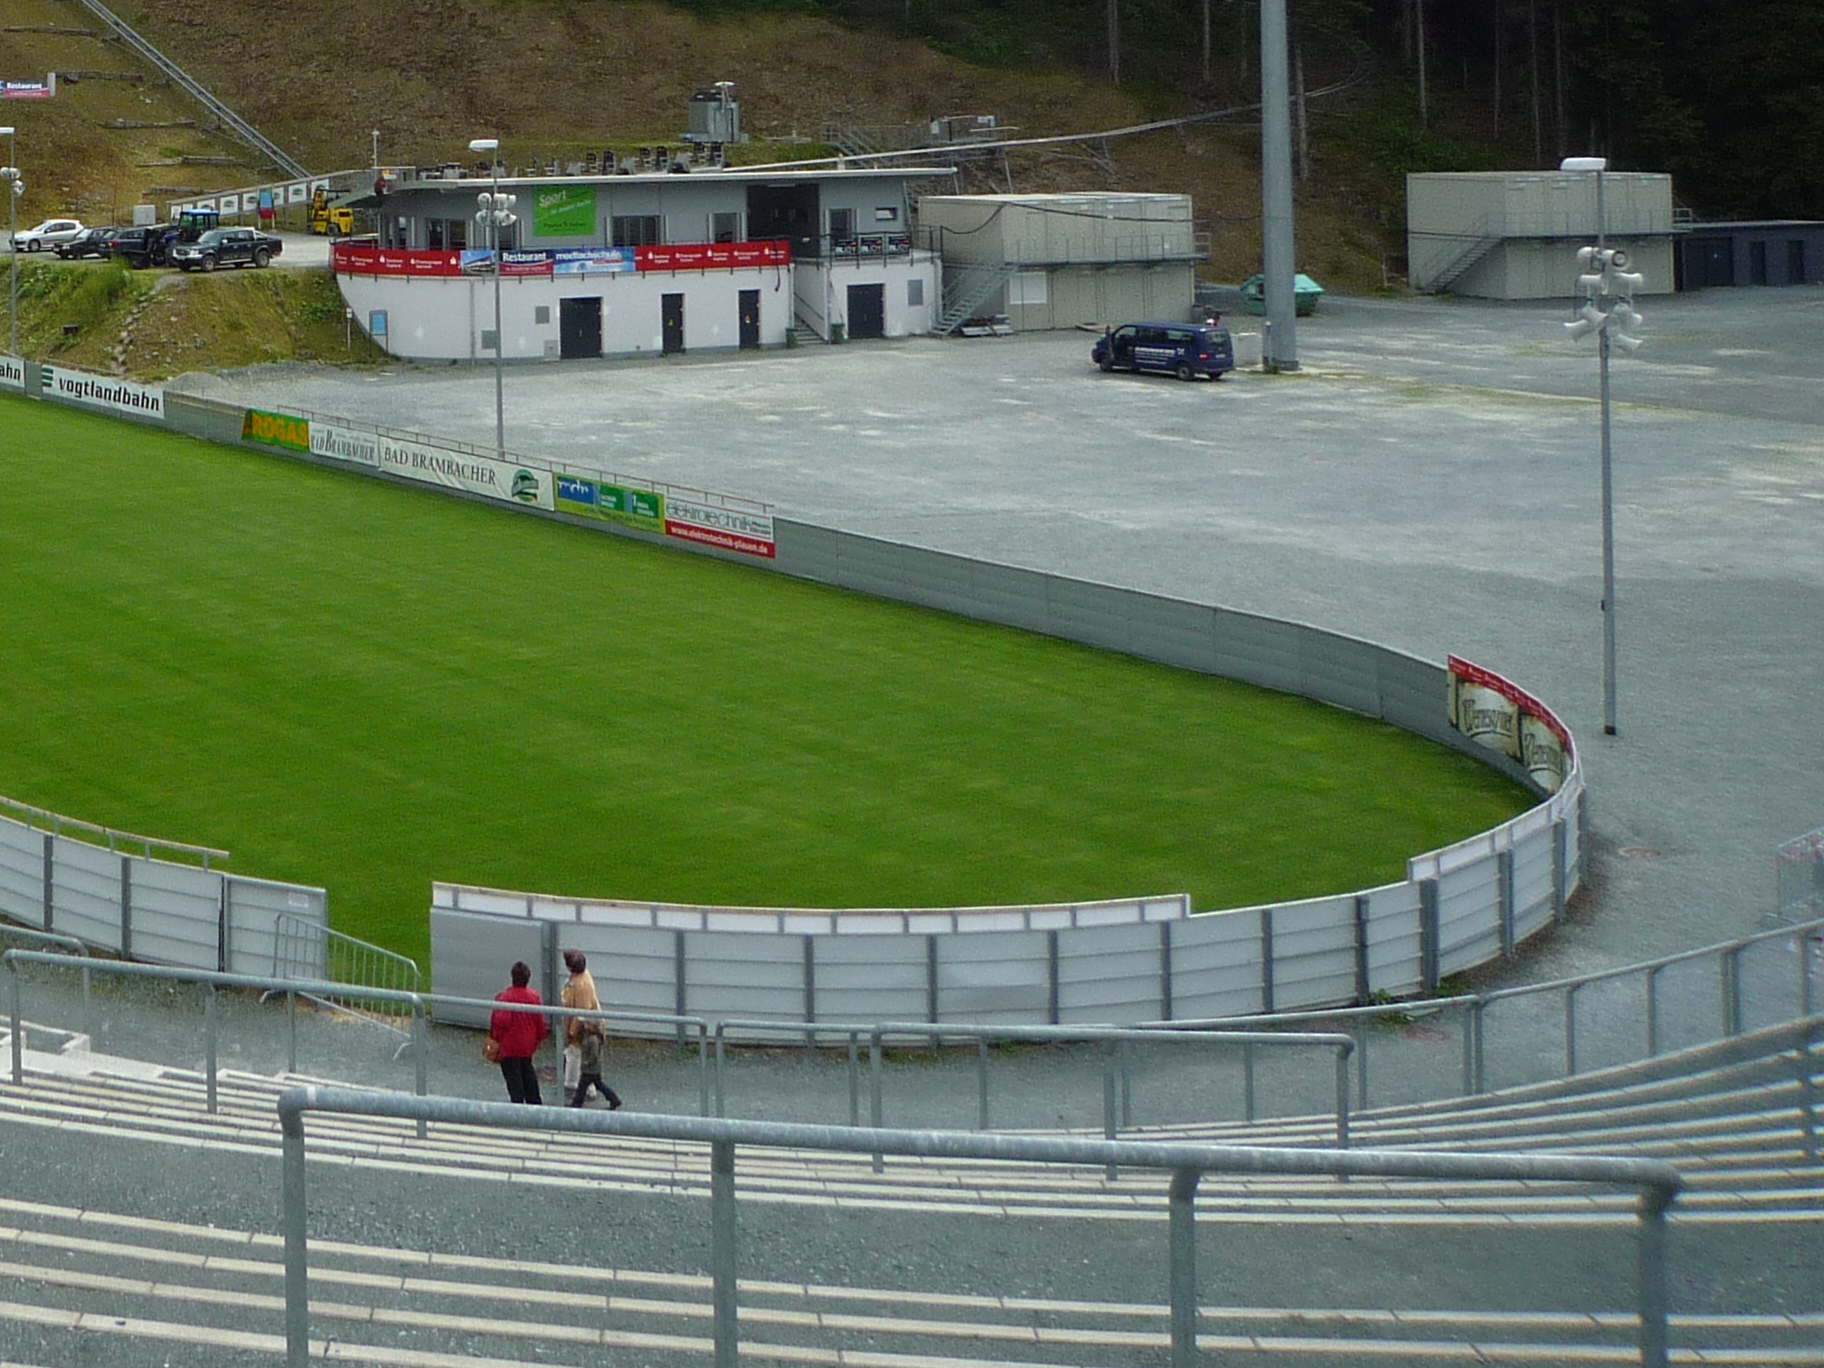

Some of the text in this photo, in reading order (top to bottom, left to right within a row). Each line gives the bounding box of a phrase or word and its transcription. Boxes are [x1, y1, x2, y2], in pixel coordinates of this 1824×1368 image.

[502, 251, 547, 262] Restaurant
[59, 376, 160, 412] vogtlandbahn
[384, 446, 408, 466] BAD
[412, 452, 496, 486] BRAMBACHER
[558, 479, 589, 494] mdr
[666, 501, 751, 531] elektrotechnik
[671, 526, 769, 554] www.elektrotechnik-plauen.de
